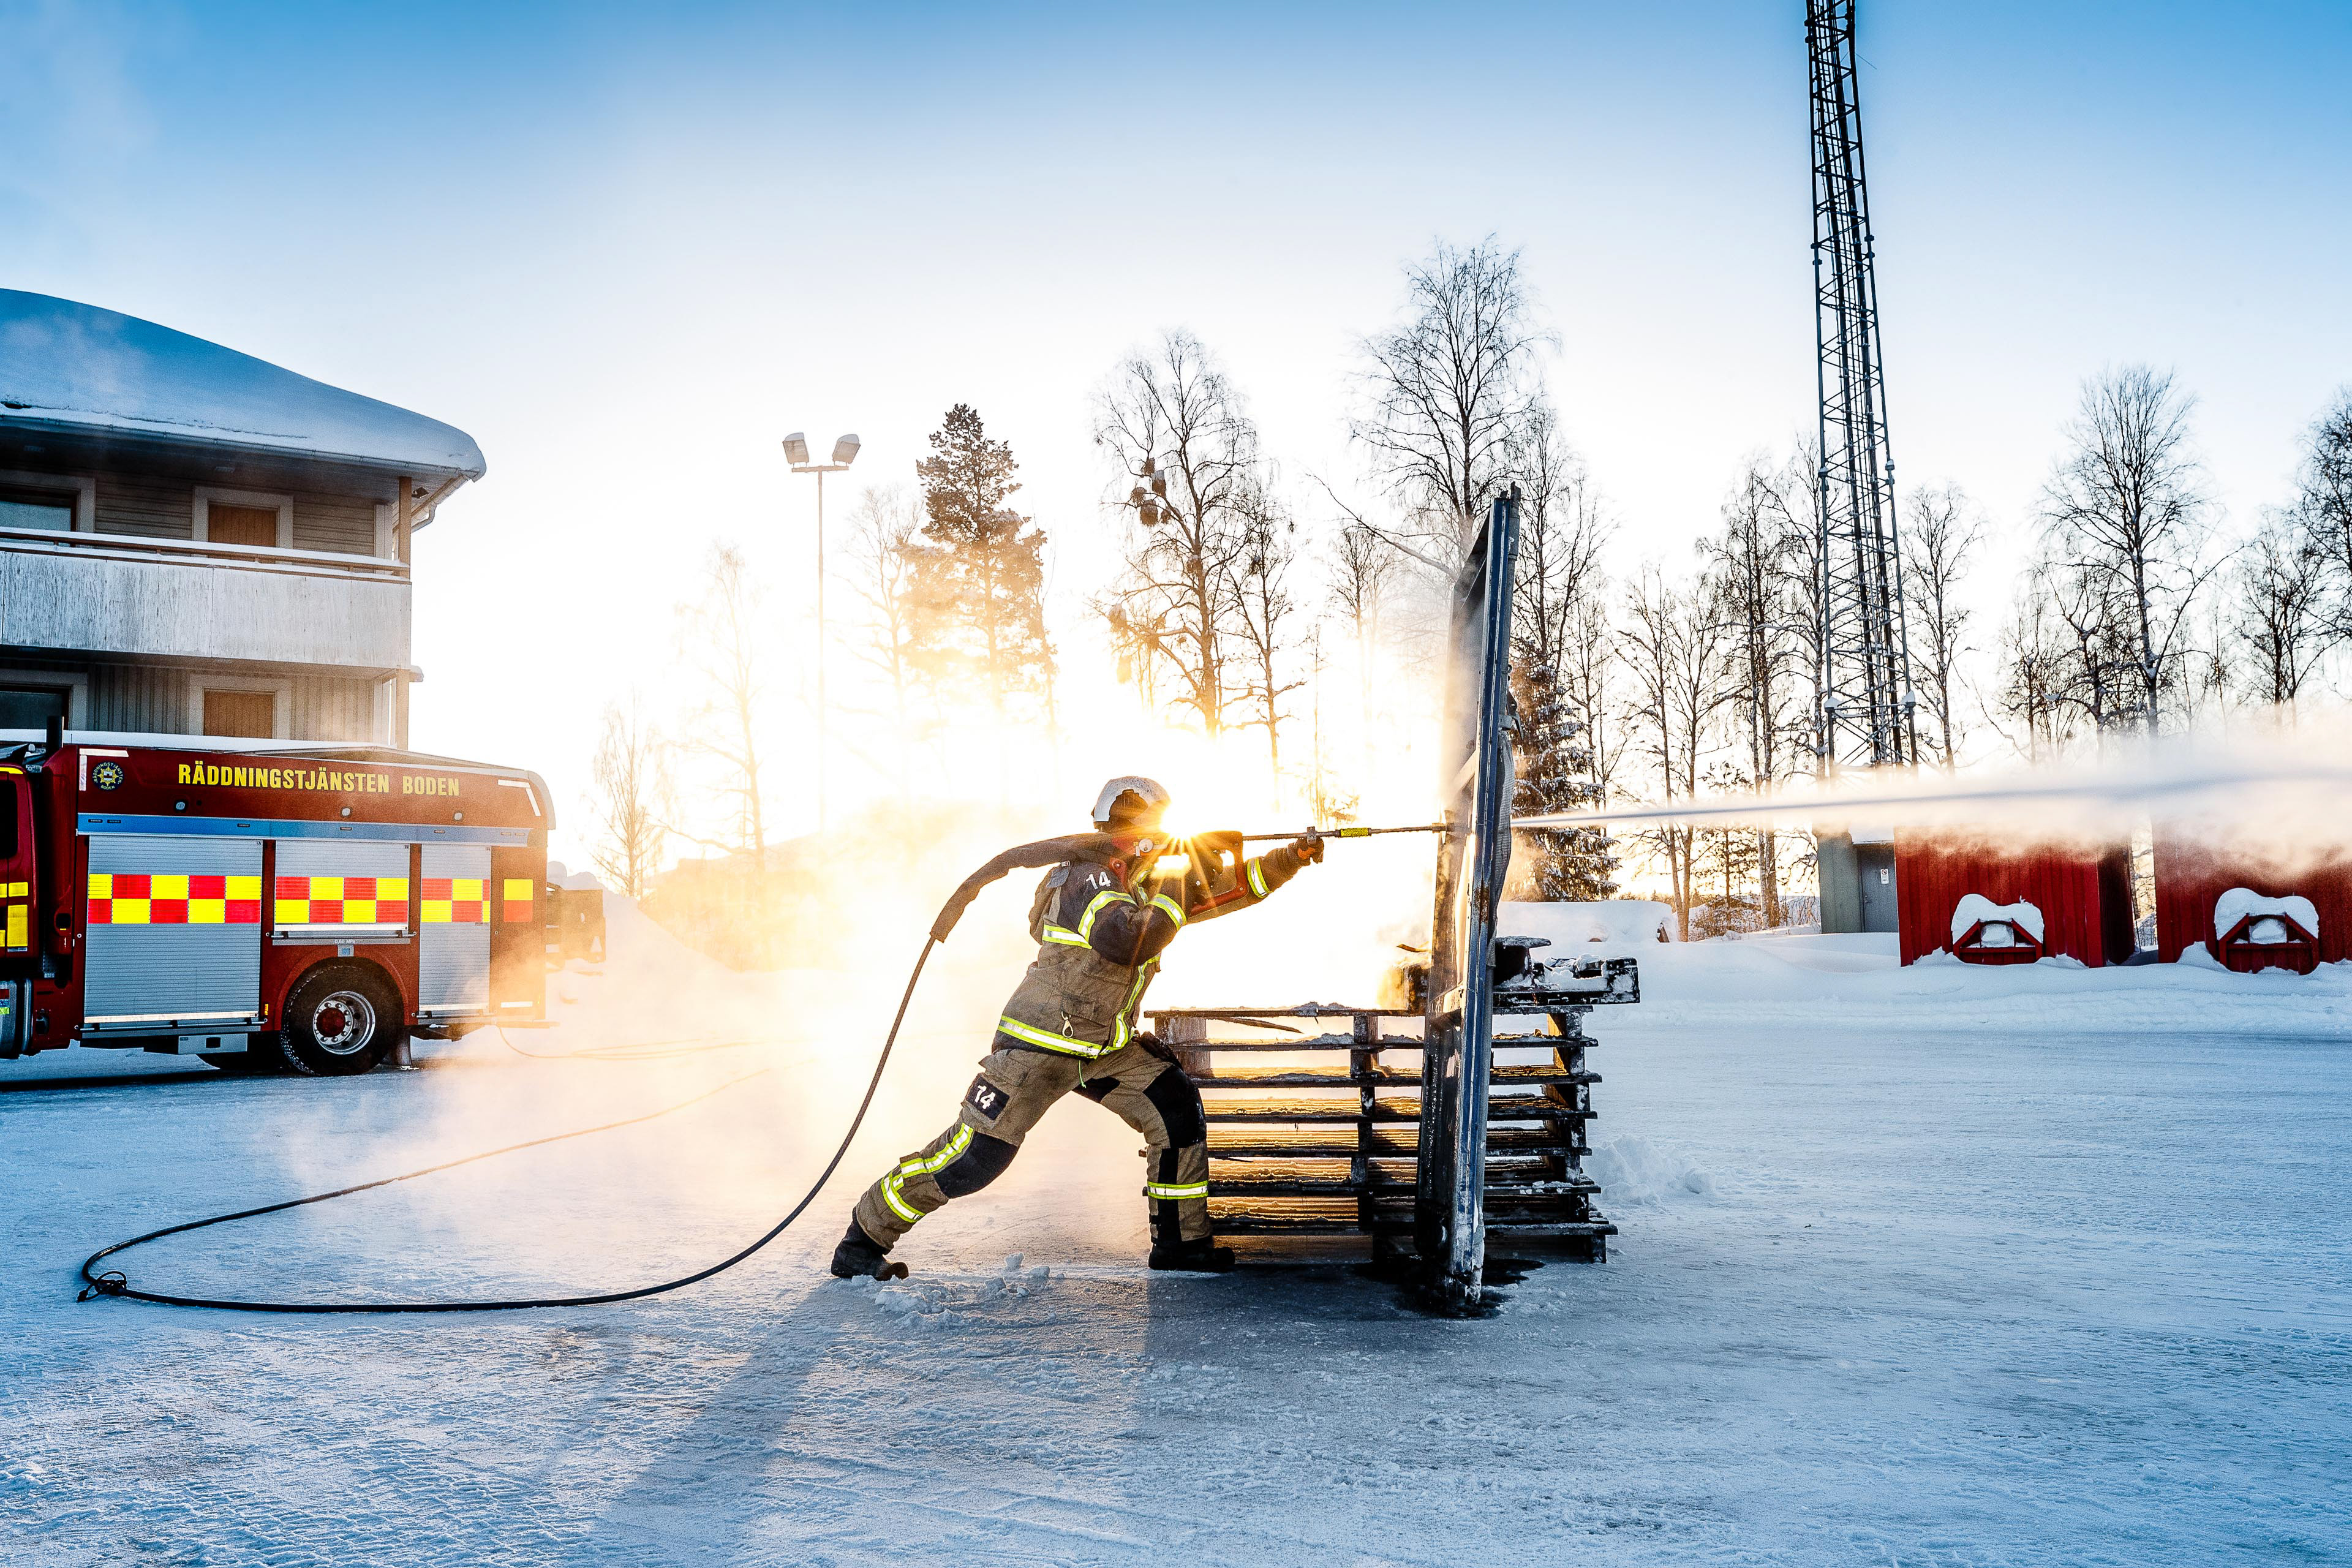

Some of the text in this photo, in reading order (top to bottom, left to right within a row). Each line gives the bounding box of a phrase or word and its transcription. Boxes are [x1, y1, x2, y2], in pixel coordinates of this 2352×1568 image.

[178, 760, 459, 796] RÄDDNINGSTJÄNSTEN BODEN
[1085, 871, 1111, 890] 14
[974, 1085, 996, 1110] 14
